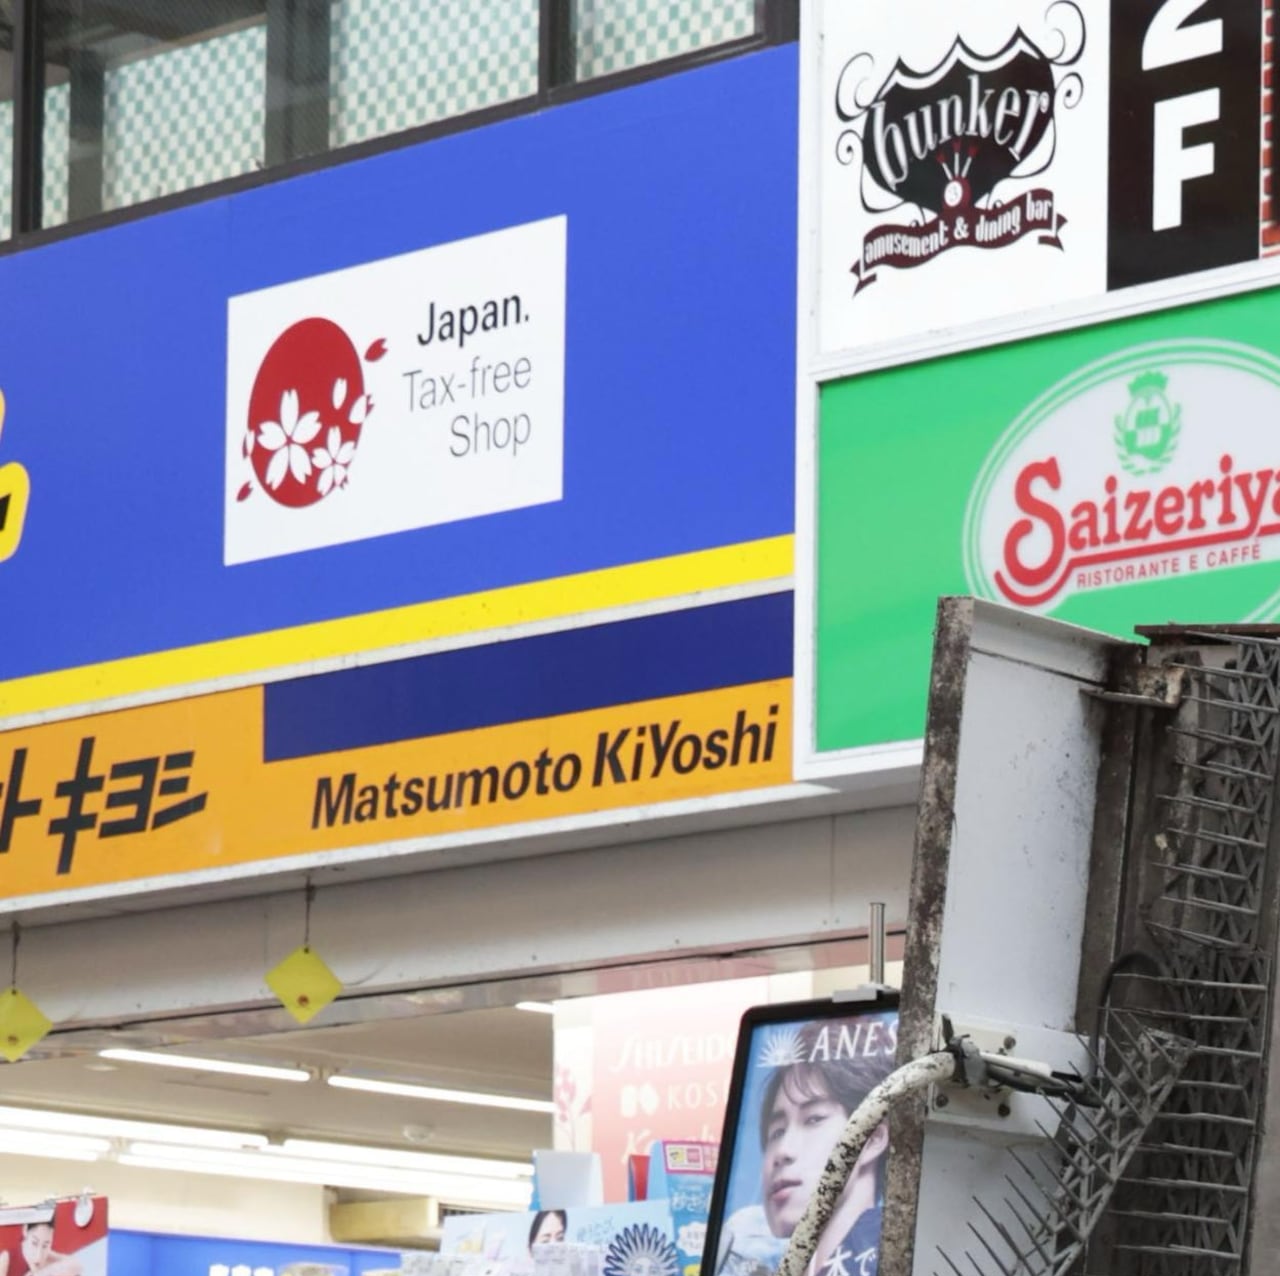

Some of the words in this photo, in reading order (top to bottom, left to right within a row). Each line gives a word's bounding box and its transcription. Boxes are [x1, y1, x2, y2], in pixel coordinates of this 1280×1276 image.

[869, 74, 1050, 191] bunker
[863, 220, 949, 264] amusement
[953, 216, 969, 240] &
[975, 206, 1021, 243] dining
[1026, 191, 1052, 222] bar
[417, 293, 530, 348] Japan.
[402, 352, 532, 414] Tax-free
[448, 411, 531, 459] Shop
[1077, 557, 1180, 589] RISTORANTE
[1188, 553, 1199, 571] E
[311, 747, 582, 829] Matsumoto
[591, 704, 780, 787] KiYoshi
[0, 735, 208, 876] トキヨシ
